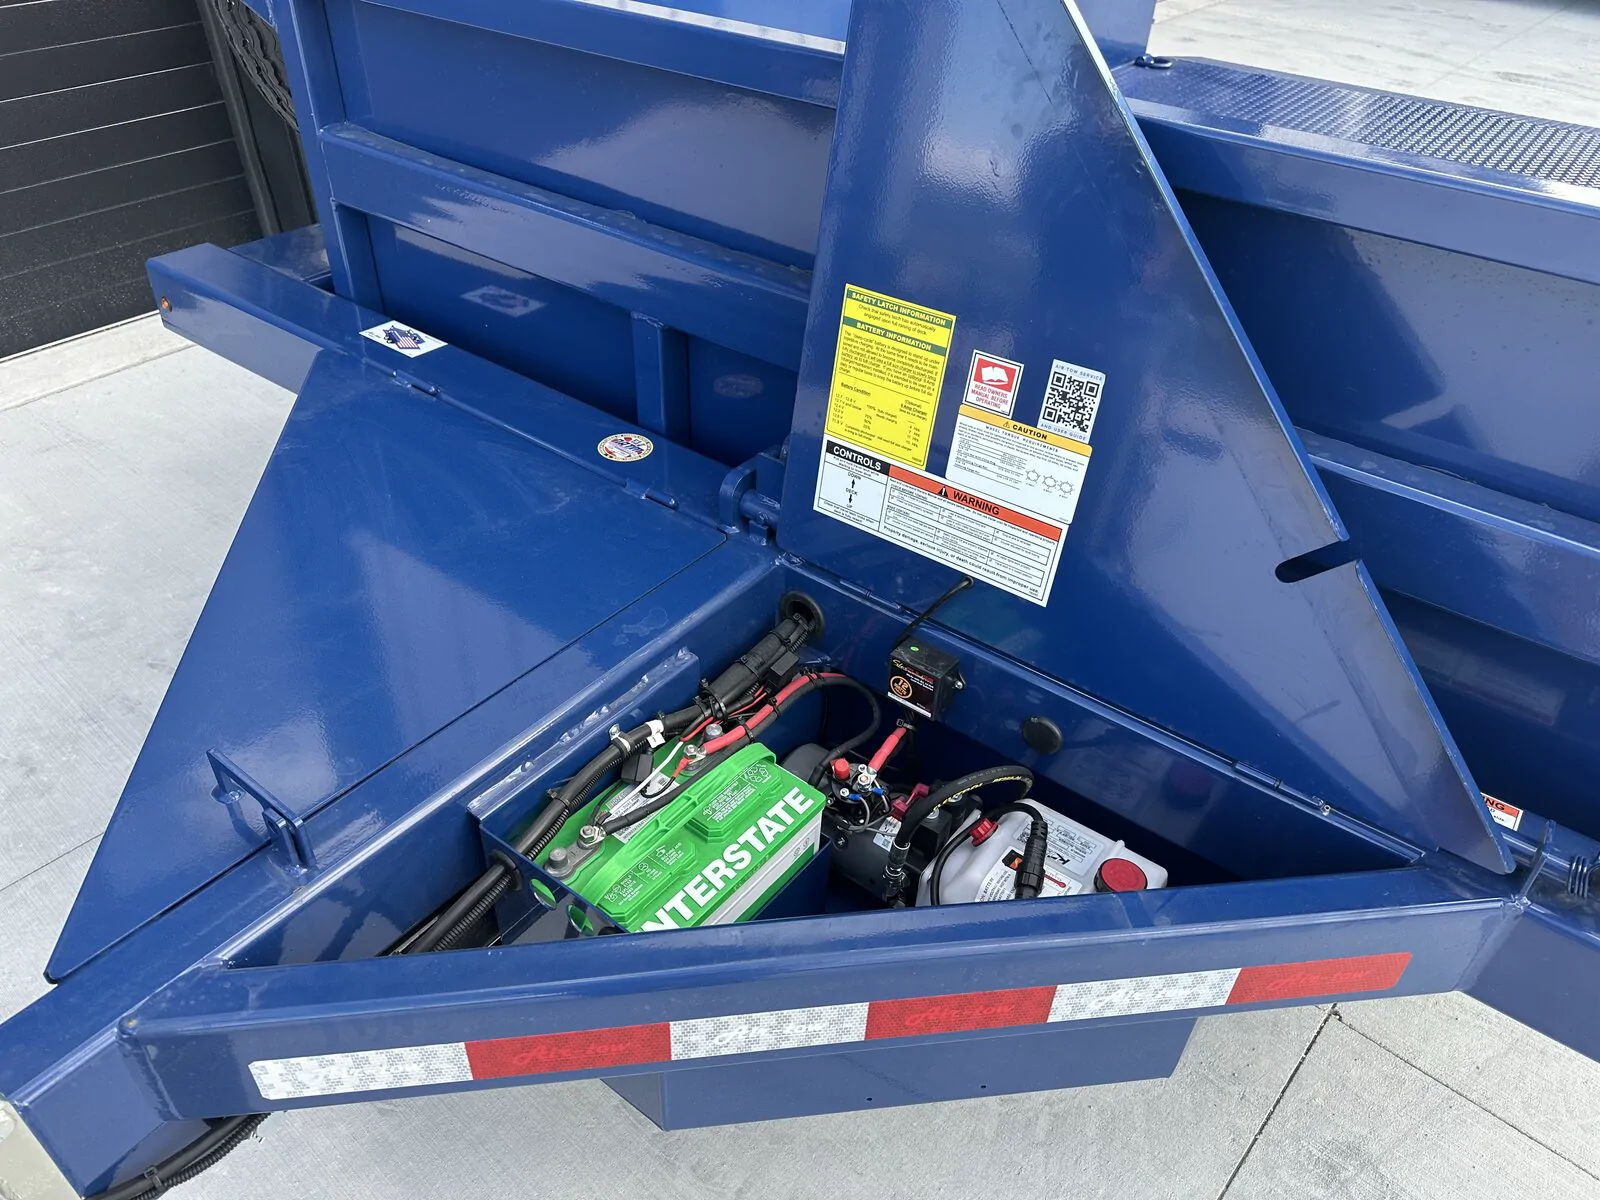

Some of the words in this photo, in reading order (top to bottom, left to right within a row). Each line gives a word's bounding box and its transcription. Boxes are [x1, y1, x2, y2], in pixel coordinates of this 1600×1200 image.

[852, 292, 876, 305] SAFETY
[877, 300, 898, 312] LATCH
[899, 307, 946, 326] INFORMATION
[858, 304, 871, 312] Check
[879, 310, 891, 319] safety
[891, 314, 901, 322] latch
[910, 319, 936, 333] automatically
[857, 322, 887, 337] BATTERY
[886, 332, 931, 351] INFORMATION
[1065, 367, 1078, 375] TOW
[1079, 371, 1103, 381] SERVICE
[841, 382, 853, 391] Battery
[854, 386, 871, 397] Condition
[971, 389, 990, 399] MANUAL
[991, 395, 1008, 405] BEFORE
[974, 384, 987, 392] READ
[987, 388, 1008, 398] OWNERS
[976, 396, 1001, 409] OPERATING
[986, 425, 1001, 433] WHEEL
[1012, 424, 1048, 441] CAUTION
[1053, 426, 1068, 434] USER
[1069, 431, 1087, 440] GUIDE
[833, 446, 882, 471] CONTROLS
[848, 472, 861, 480] DOWN
[845, 488, 858, 496] DECK
[952, 491, 1000, 516] WARNING
[883, 525, 901, 536] Property
[902, 533, 919, 544] damage,
[920, 541, 935, 550] serious
[936, 547, 950, 557] injury,
[956, 555, 968, 564] death
[969, 561, 982, 570] could
[982, 566, 996, 576] result
[996, 572, 1007, 581] from
[1007, 577, 1029, 590] improper
[898, 679, 909, 691] 12
[636, 787, 815, 932] NTERSTATE
